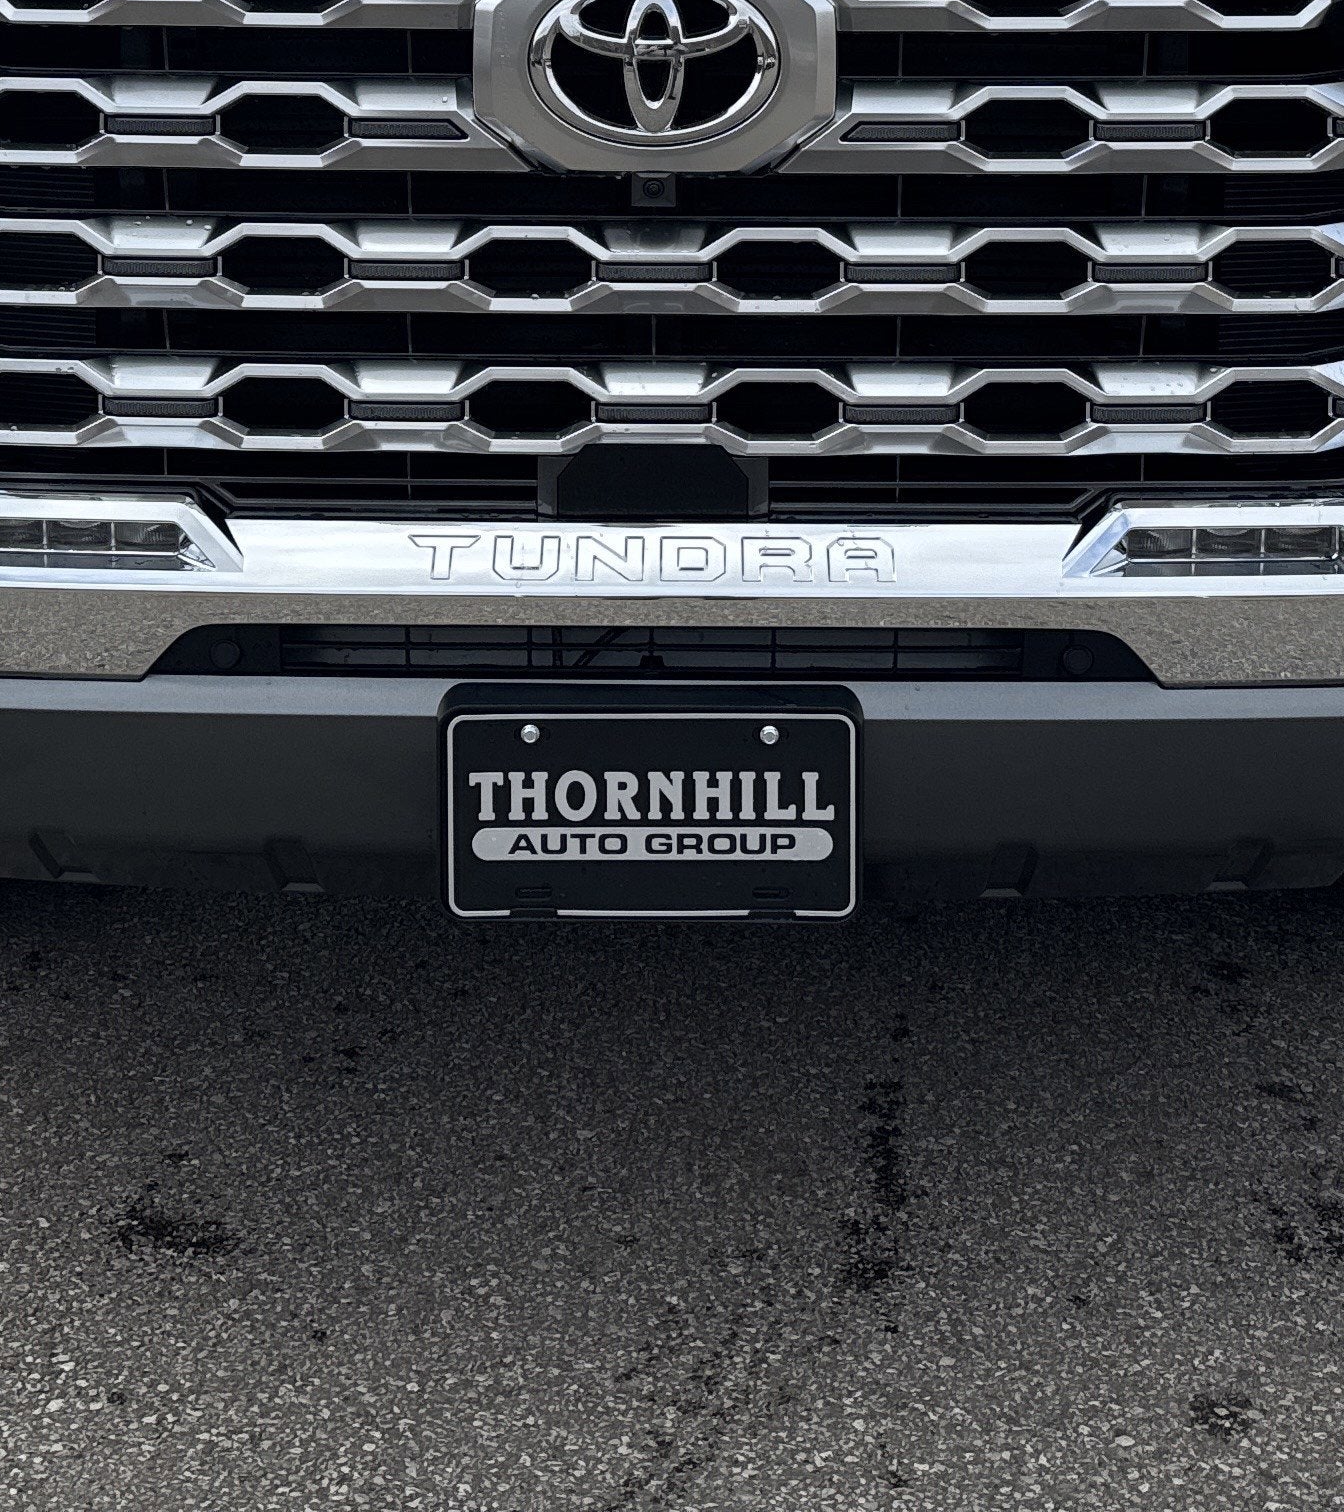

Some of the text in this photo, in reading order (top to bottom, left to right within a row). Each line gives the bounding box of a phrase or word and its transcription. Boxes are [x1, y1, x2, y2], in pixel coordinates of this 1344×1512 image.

[407, 534, 897, 583] TUNDRA
[468, 769, 836, 823] THORNHILL
[508, 833, 798, 856] AUTO GROUP
